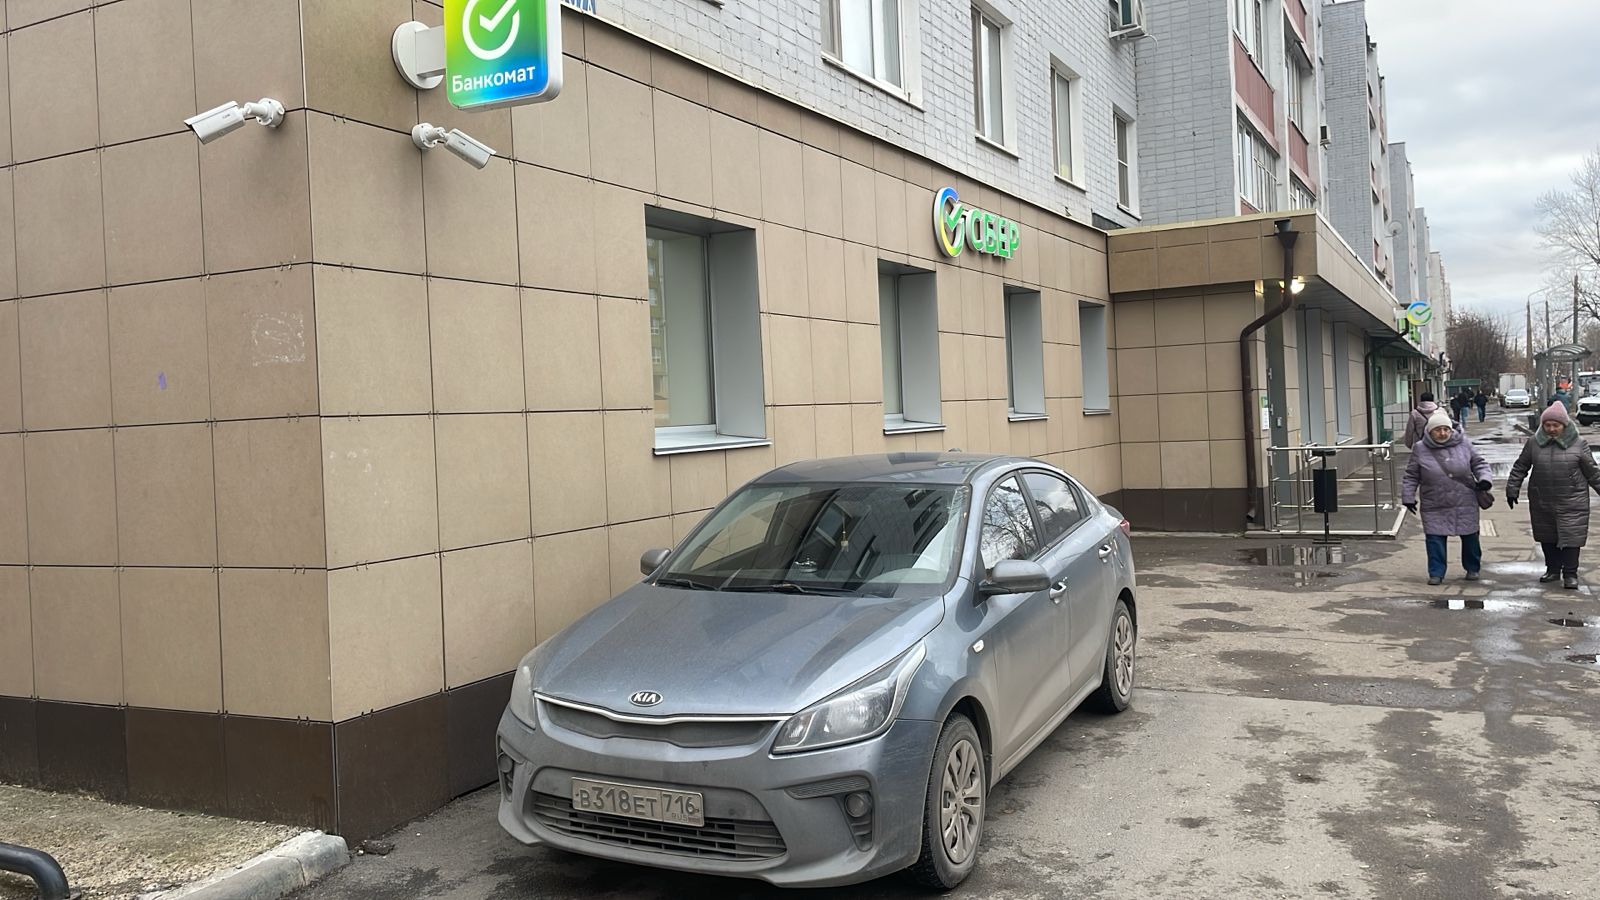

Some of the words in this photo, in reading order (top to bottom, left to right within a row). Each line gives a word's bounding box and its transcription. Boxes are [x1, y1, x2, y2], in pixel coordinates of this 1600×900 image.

[452, 66, 536, 94] Банкомат
[966, 208, 1020, 259] СБЕР
[633, 692, 658, 703] KIA
[579, 787, 657, 817] В318ЕТ
[663, 793, 696, 815] 716
